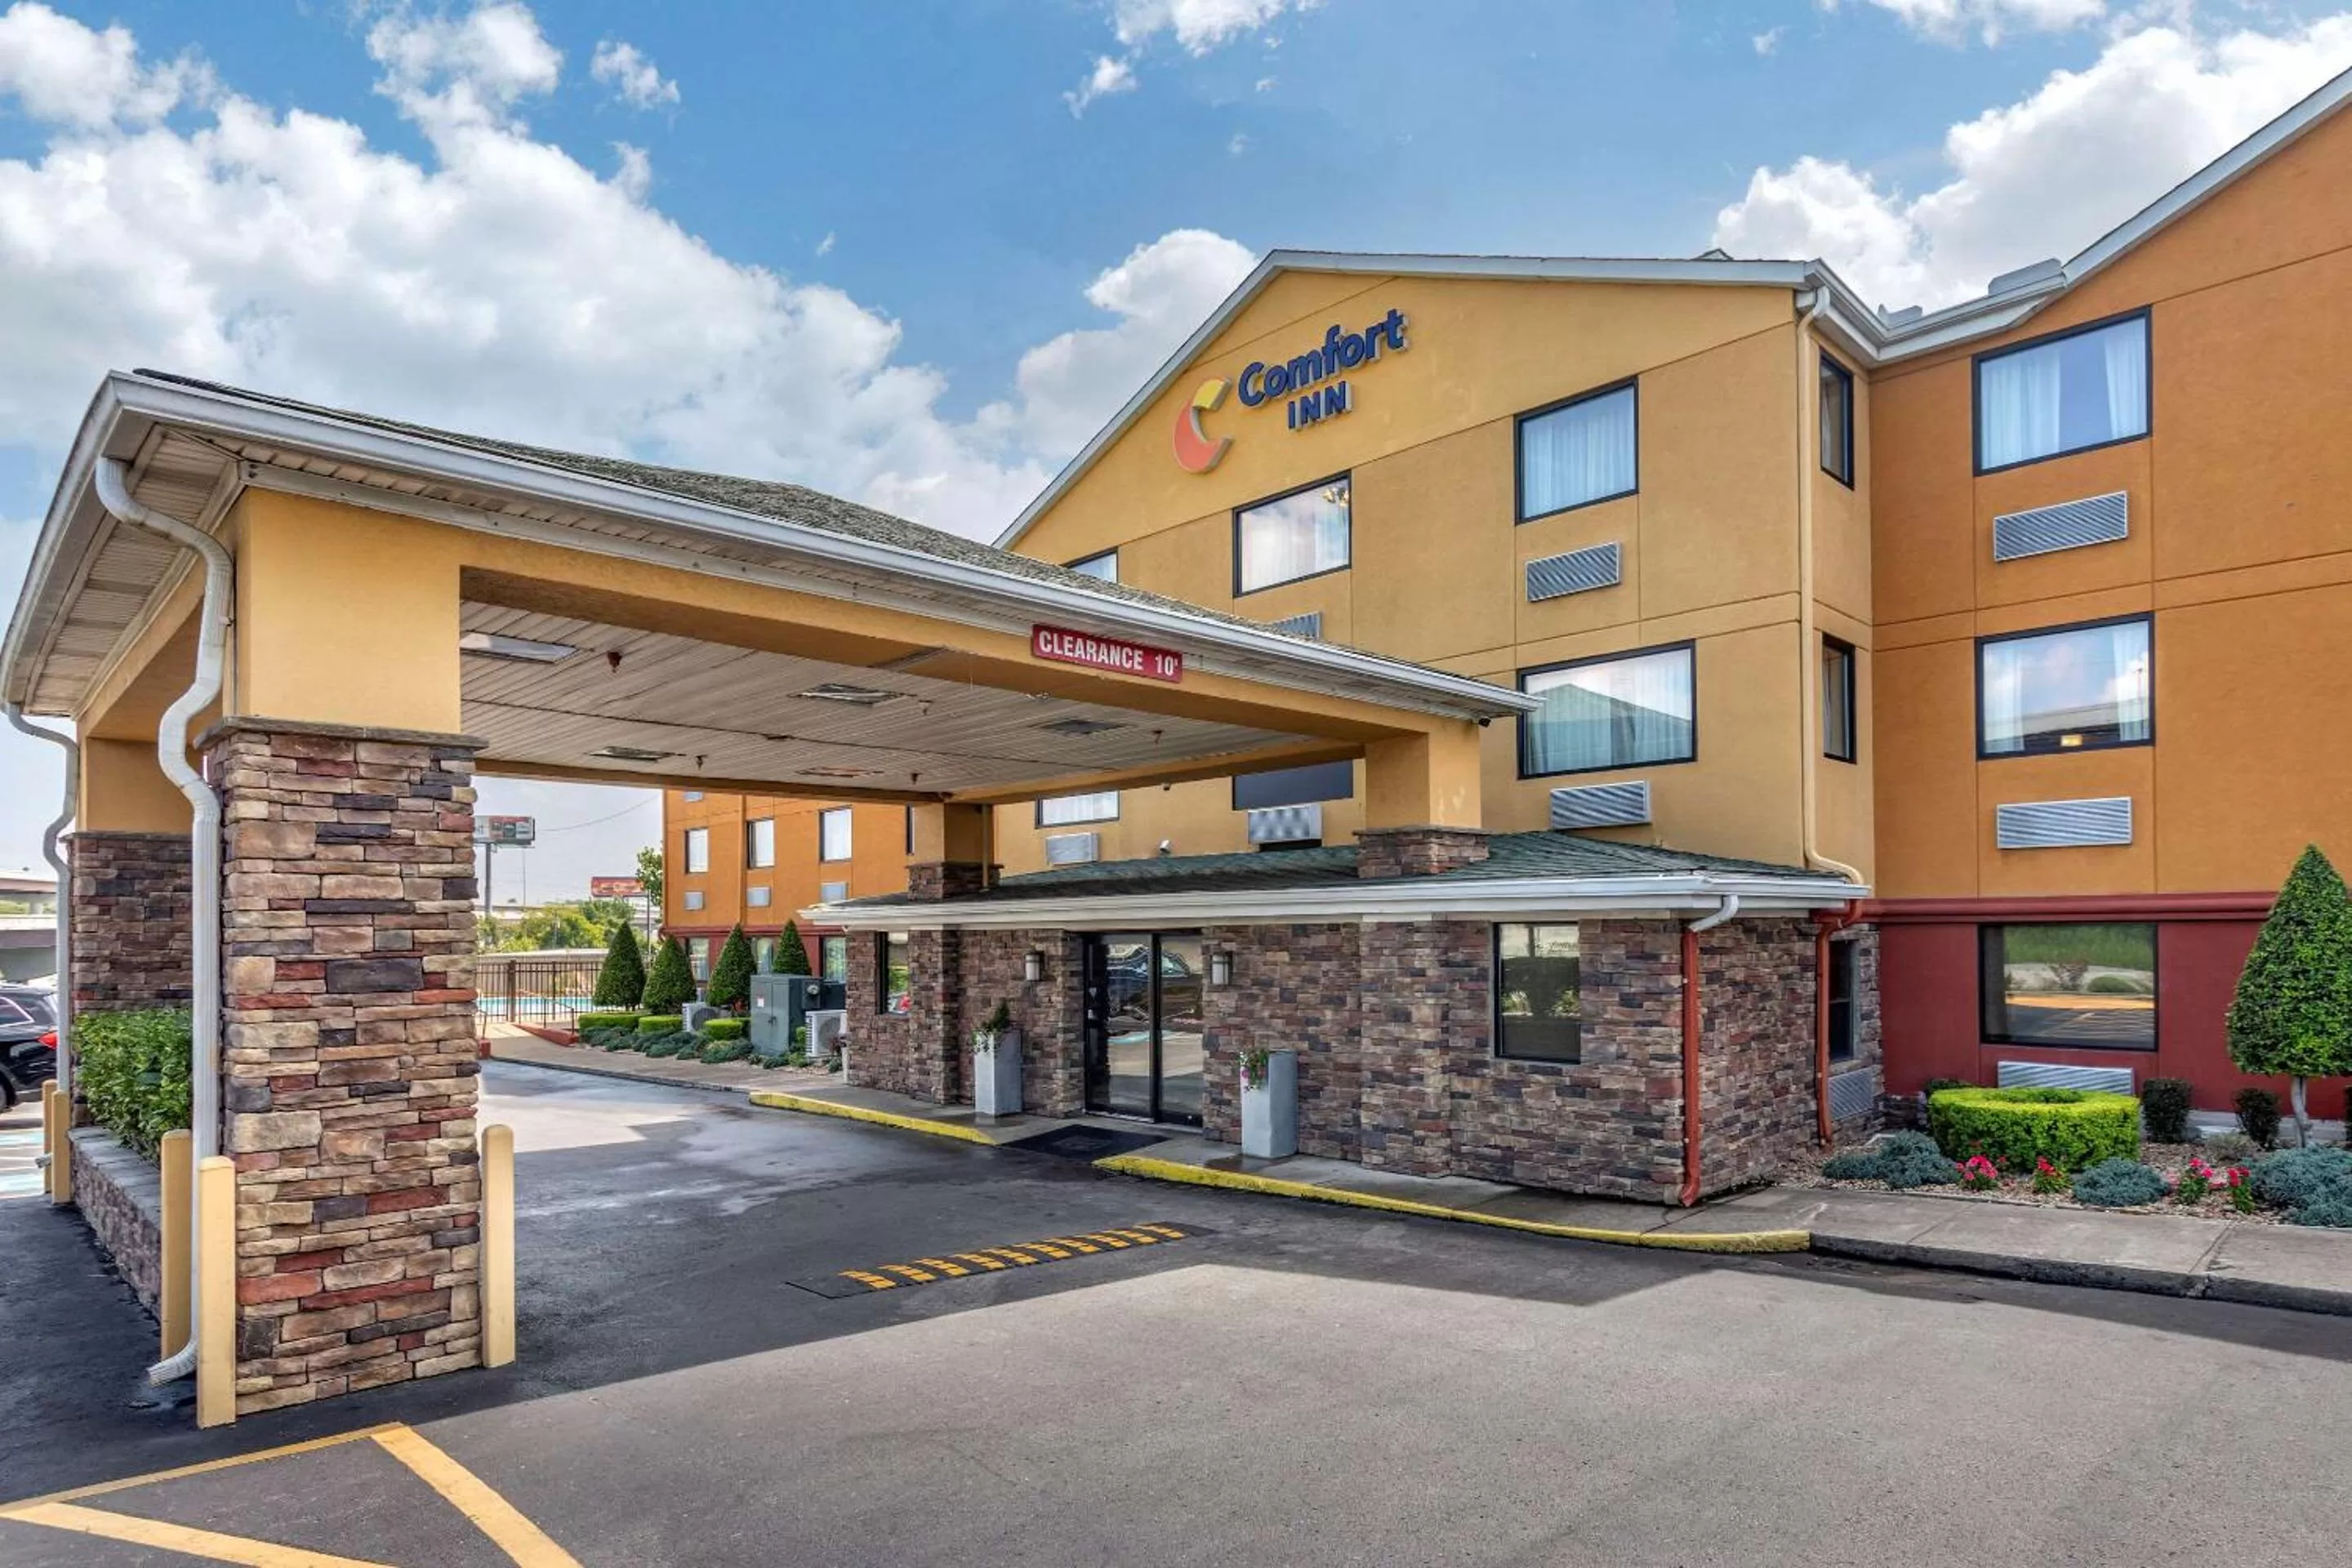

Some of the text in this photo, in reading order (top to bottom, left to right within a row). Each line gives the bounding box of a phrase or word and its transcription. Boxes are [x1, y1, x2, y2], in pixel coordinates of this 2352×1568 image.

[1237, 308, 1406, 408] Comfort
[1287, 380, 1349, 430] INN
[1039, 630, 1144, 670] CLEARANCE
